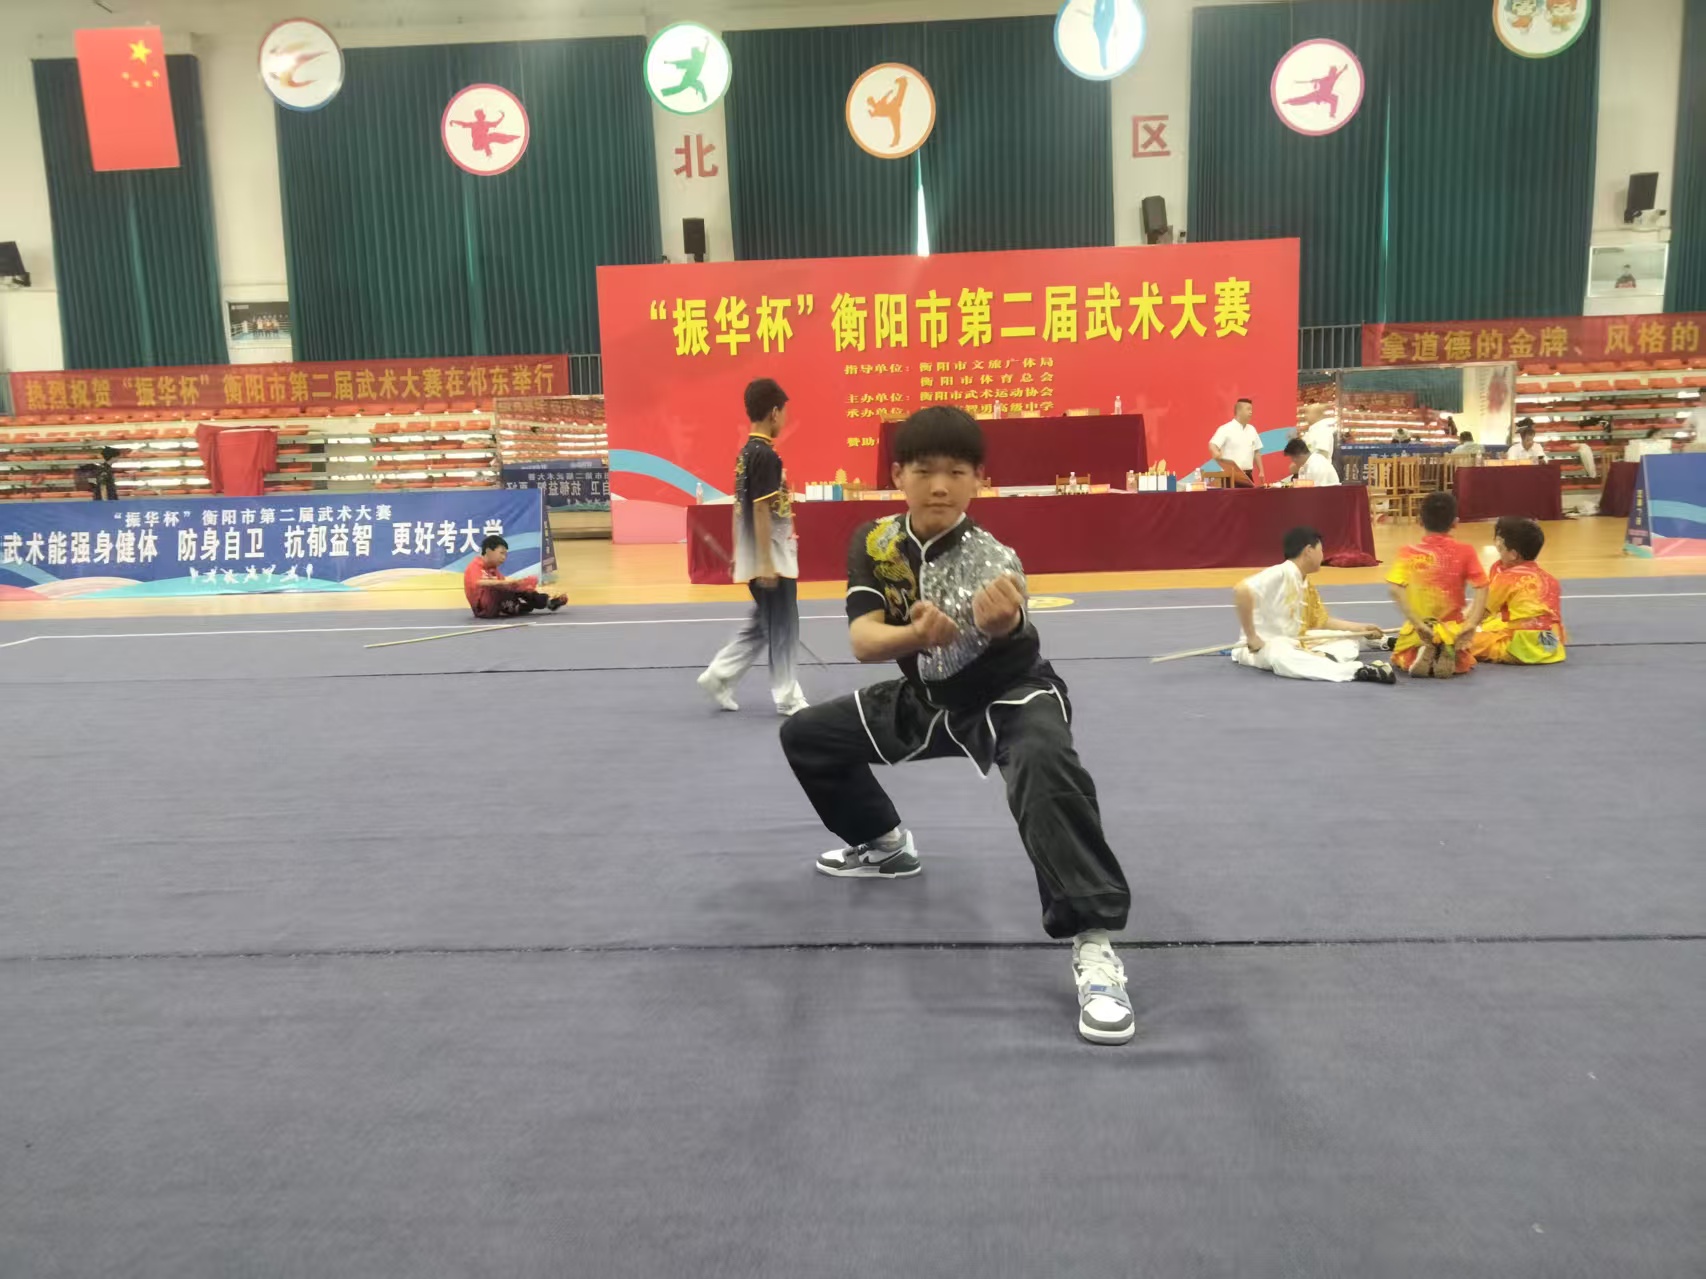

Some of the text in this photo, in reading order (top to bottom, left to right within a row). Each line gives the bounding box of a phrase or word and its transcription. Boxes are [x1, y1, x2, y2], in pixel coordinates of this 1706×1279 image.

[674, 135, 718, 177] 北
[1132, 115, 1170, 157] 区
[650, 276, 1251, 356] “振华杯”衡阳市第二届武术大赛
[3, 529, 158, 565] 武术能强身健体
[178, 526, 265, 562] 防身自卫
[284, 523, 373, 558] 抗郁益智
